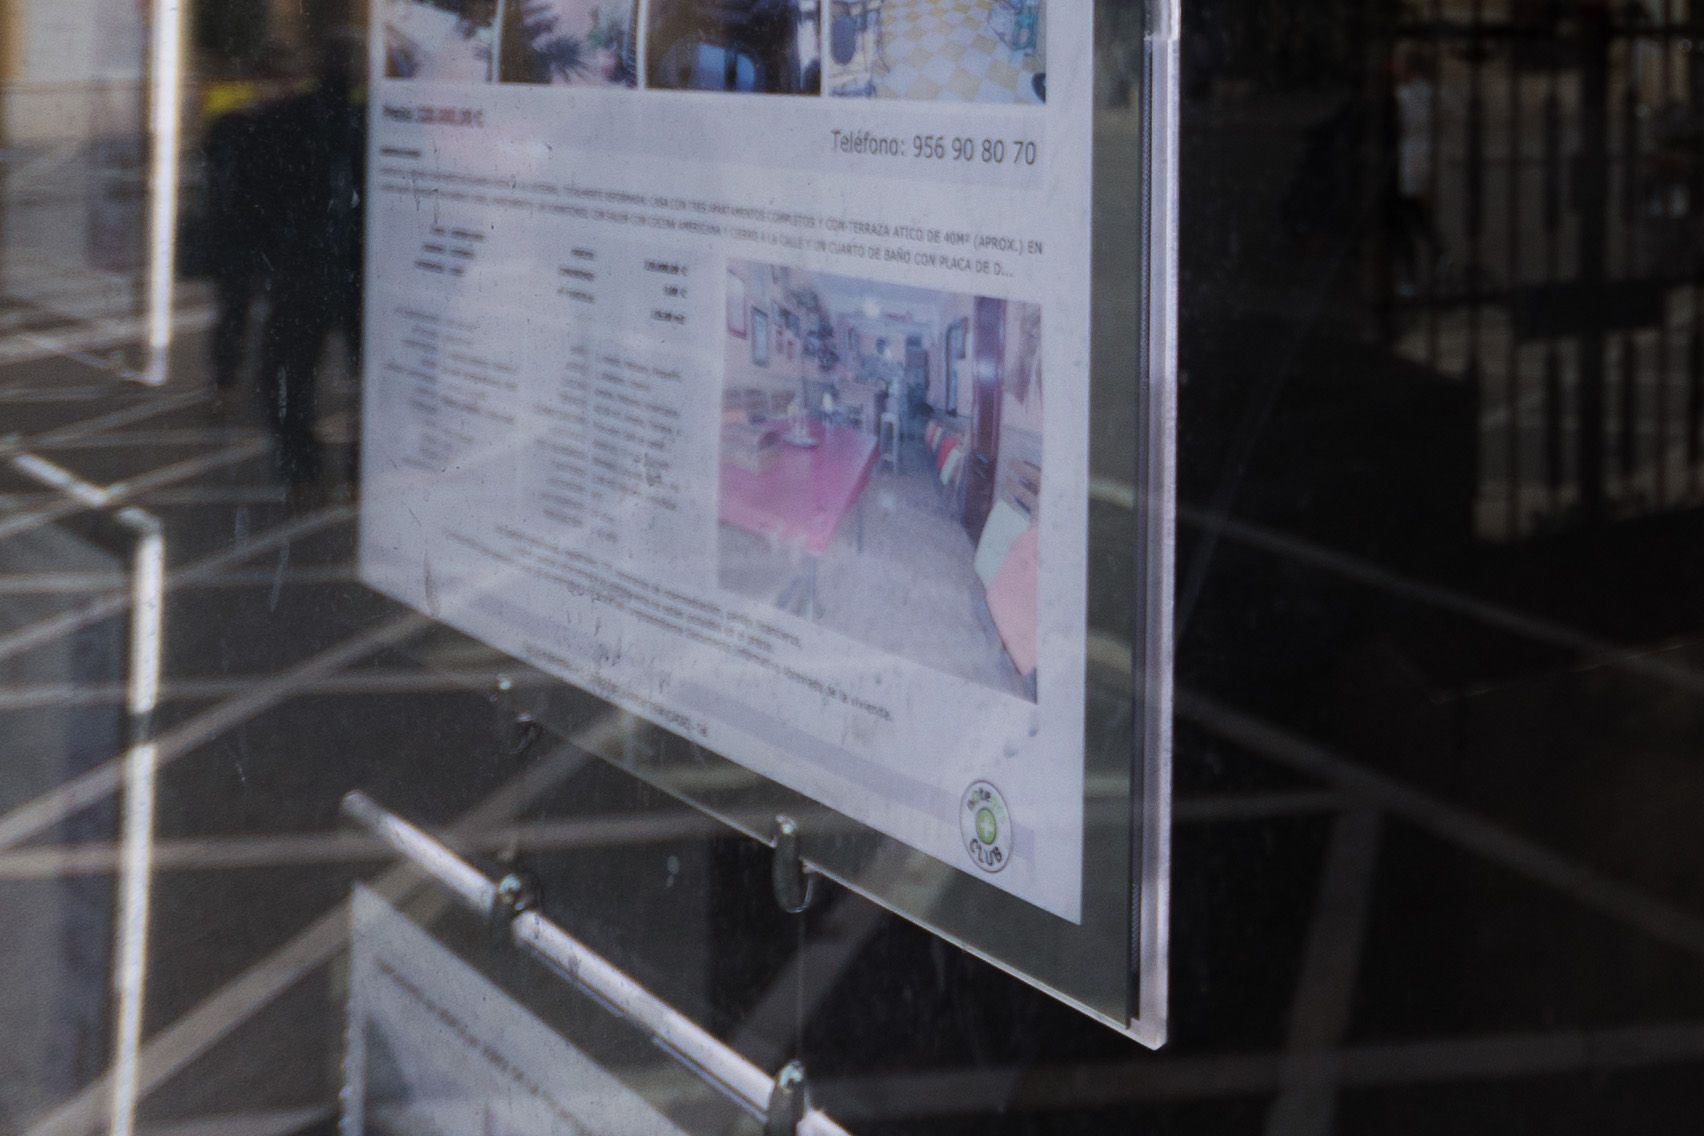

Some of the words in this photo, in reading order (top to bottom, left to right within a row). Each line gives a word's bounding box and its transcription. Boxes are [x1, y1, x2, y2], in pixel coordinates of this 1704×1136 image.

[831, 128, 905, 157] Teléfono:
[912, 133, 946, 160] 956
[951, 136, 975, 162] 90
[980, 137, 1006, 164] 80
[1012, 140, 1038, 166] 70
[893, 225, 925, 242] ATICO
[926, 229, 940, 243] DE
[1027, 239, 1043, 256] EN
[975, 259, 990, 275] DE
